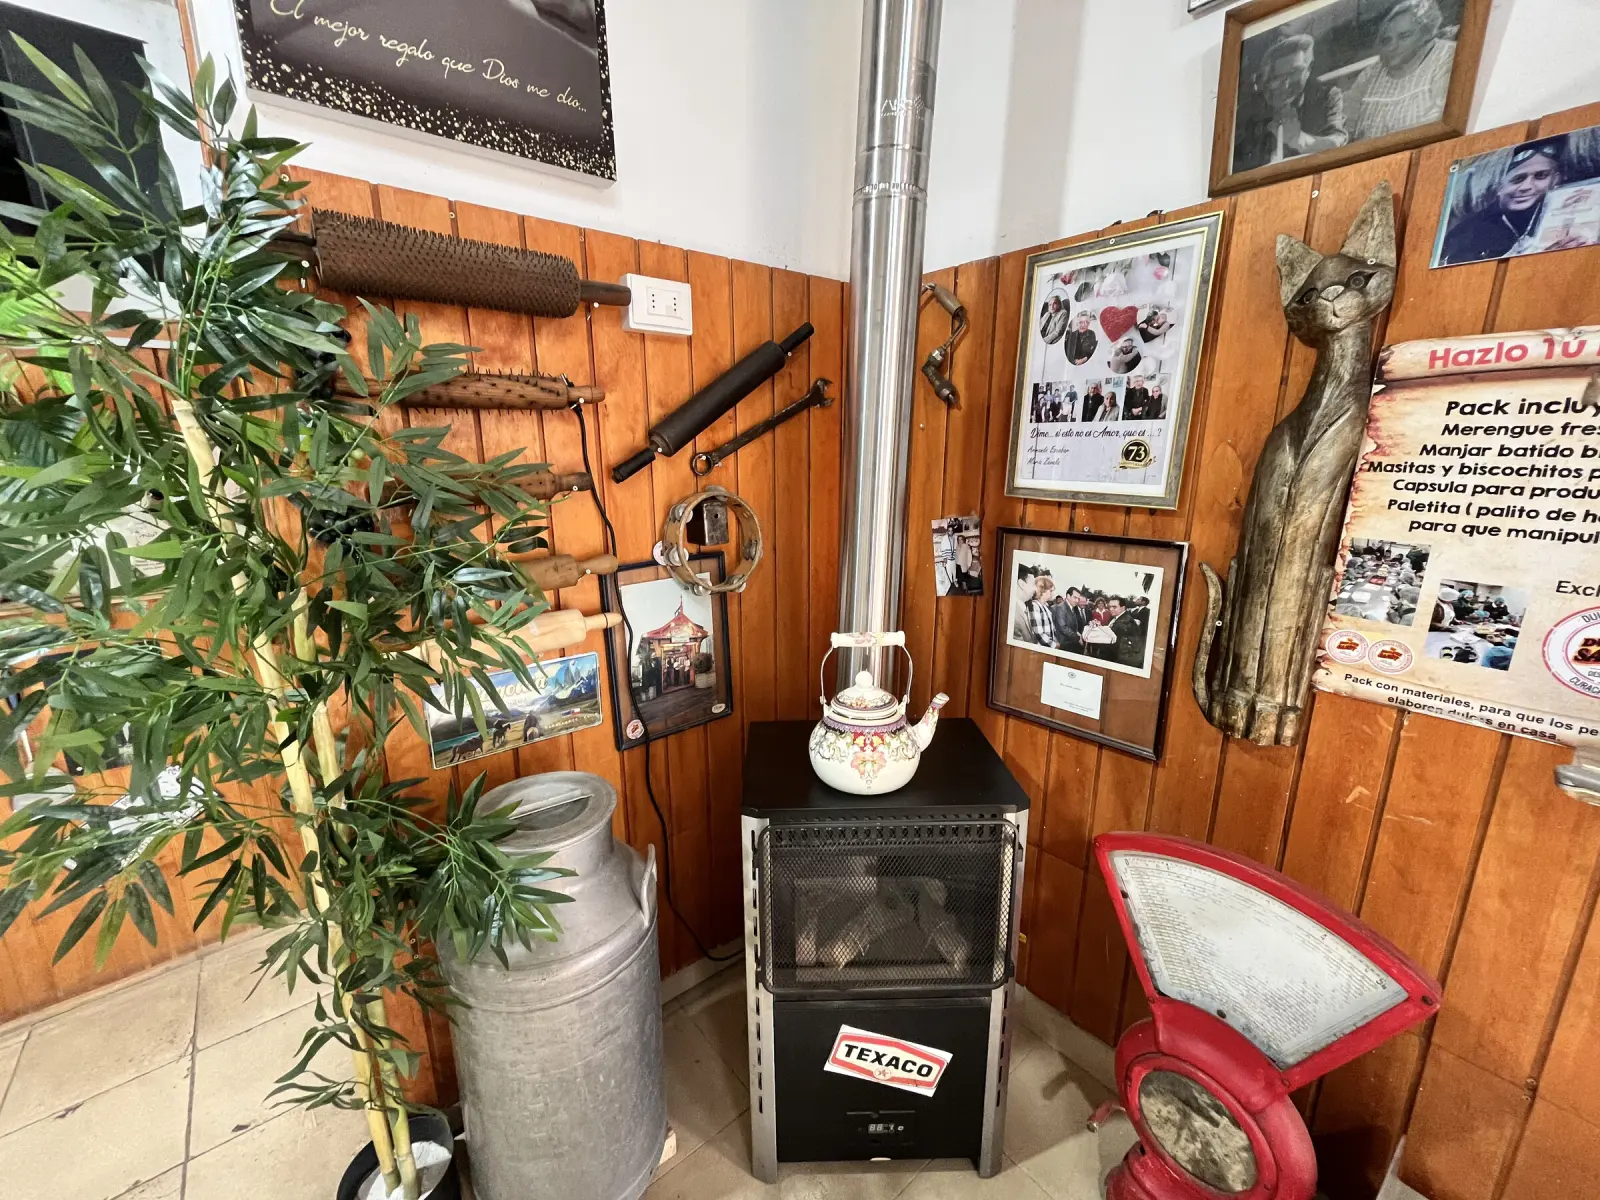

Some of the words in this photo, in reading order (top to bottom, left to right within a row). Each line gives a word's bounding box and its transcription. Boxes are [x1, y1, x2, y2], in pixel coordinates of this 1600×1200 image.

[314, 15, 370, 46] mejor
[379, 35, 435, 67] regalo
[441, 57, 476, 79] que
[482, 58, 520, 89] Dios
[527, 83, 551, 98] me
[1428, 342, 1528, 370] Hazlo
[1445, 399, 1510, 416] Pack
[1441, 423, 1553, 438] Merengue
[1128, 445, 1145, 460] 73
[1419, 444, 1492, 459] Manjar
[1497, 444, 1574, 458] batido
[1580, 444, 1600, 458] b
[1367, 461, 1436, 474] Masitas
[1442, 465, 1453, 477] y
[1458, 462, 1583, 479] biscochitos
[1393, 479, 1467, 493] Capsula
[1471, 485, 1525, 497] para
[1529, 486, 1600, 499] produ
[1387, 499, 1461, 514] Paletita
[1476, 505, 1540, 519] palito
[1546, 508, 1577, 521] de
[1582, 509, 1600, 523] h
[1408, 520, 1457, 533] para
[1461, 524, 1502, 537] que
[1507, 528, 1600, 545] manipul
[1344, 673, 1373, 687] Pack
[1376, 680, 1399, 692] con
[1402, 687, 1474, 710] materiales,
[1479, 704, 1511, 718] para
[1516, 711, 1544, 726] que
[1549, 717, 1573, 731] los
[1498, 721, 1516, 732] en
[844, 1043, 933, 1078] TEXACO
